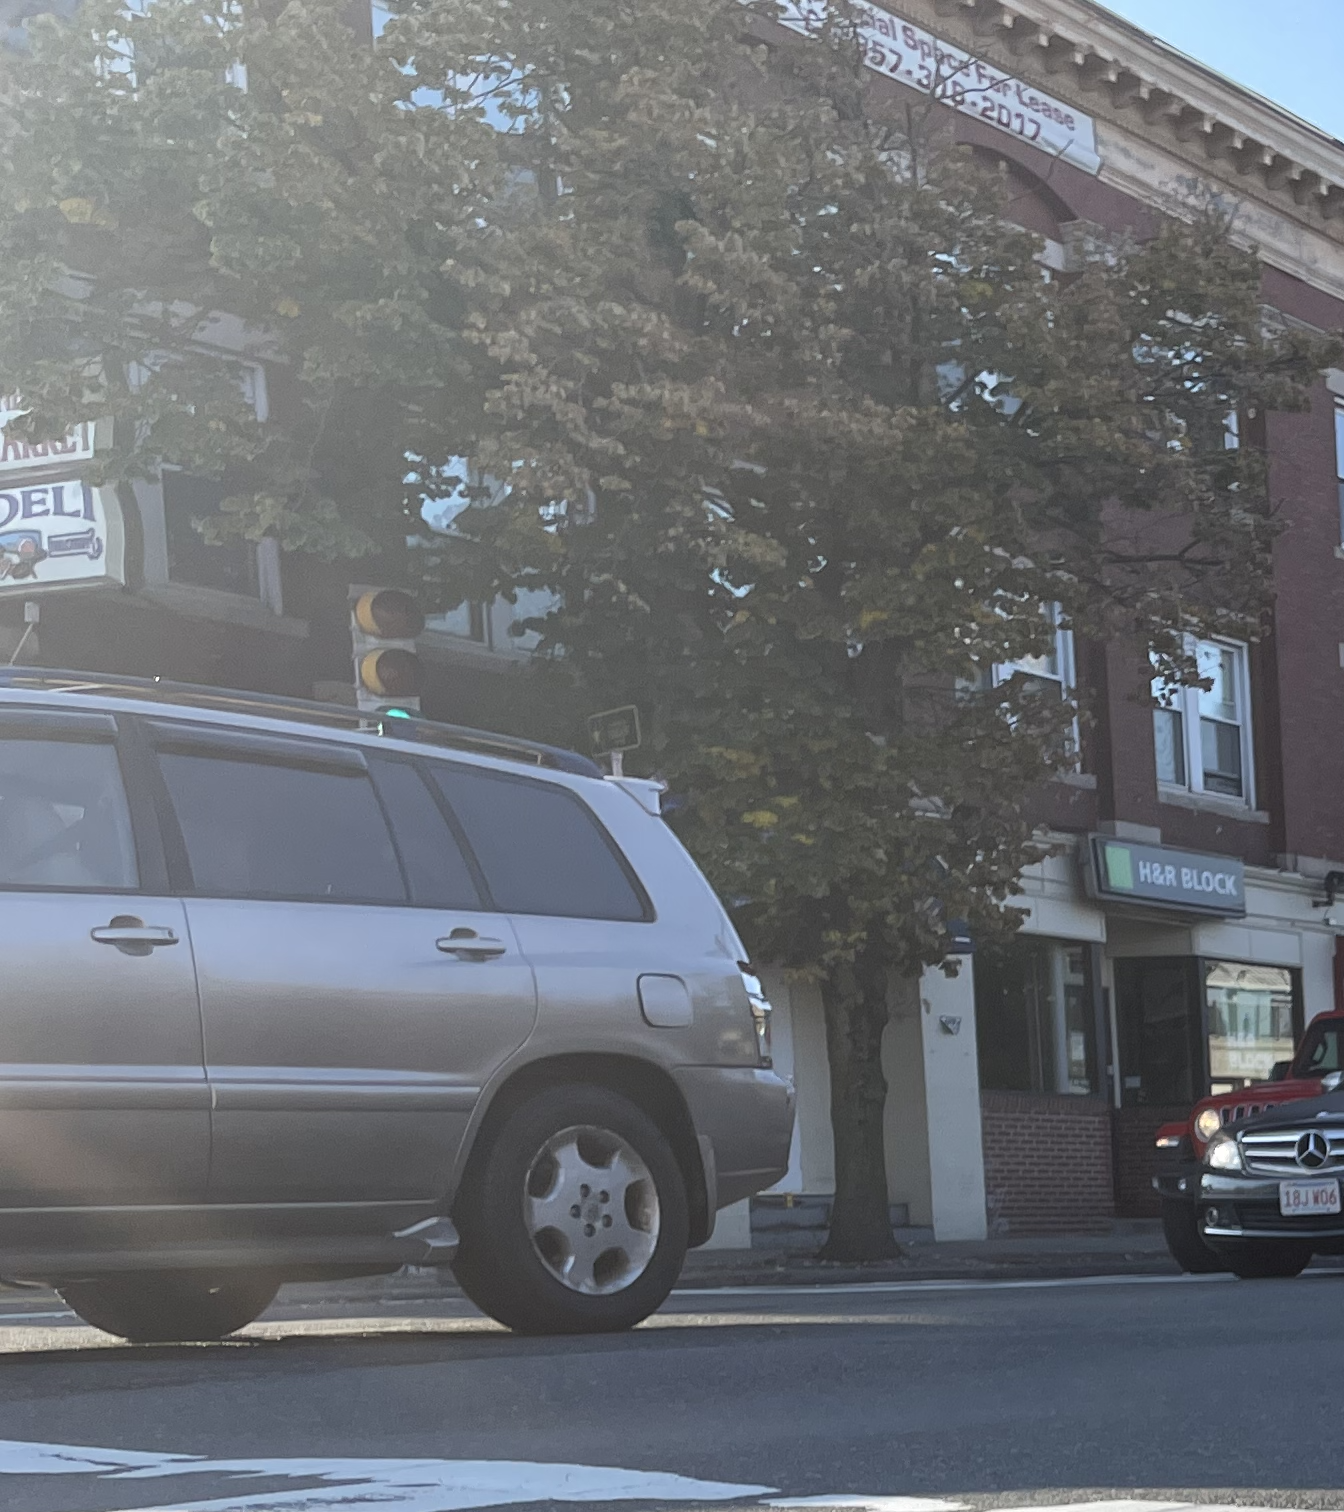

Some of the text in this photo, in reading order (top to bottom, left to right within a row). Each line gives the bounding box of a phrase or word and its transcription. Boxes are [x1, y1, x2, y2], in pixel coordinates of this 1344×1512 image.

[1015, 83, 1075, 131] Lease
[1138, 860, 1237, 896] H&R BLOCK
